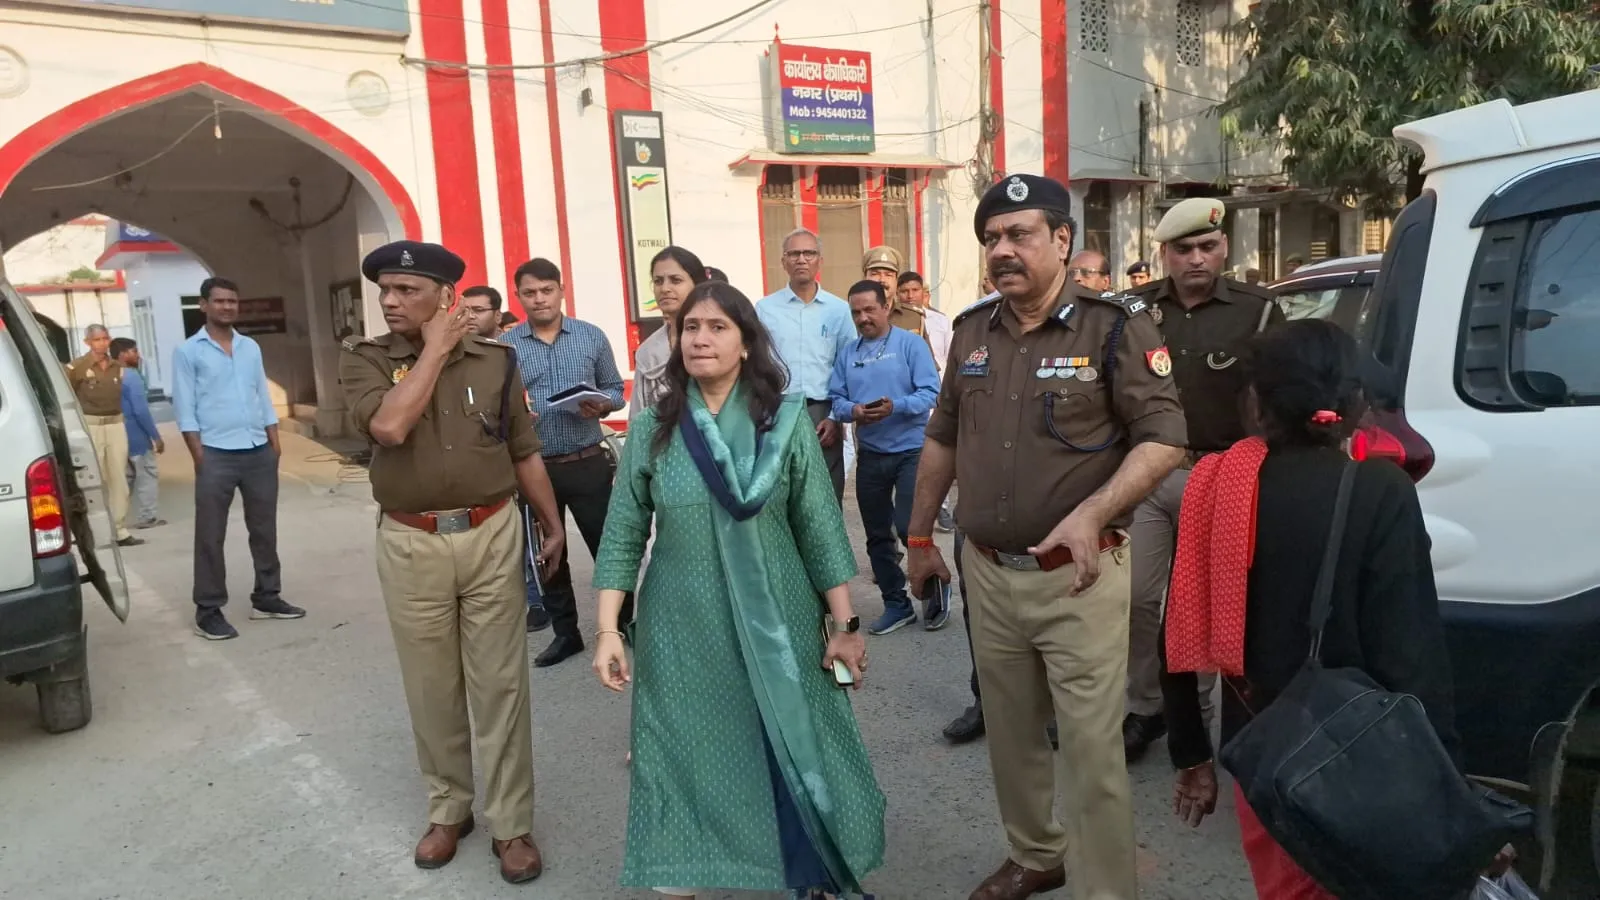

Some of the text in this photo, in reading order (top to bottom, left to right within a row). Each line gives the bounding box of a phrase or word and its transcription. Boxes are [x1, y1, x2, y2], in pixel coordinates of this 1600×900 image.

[783, 53, 822, 80] कार्यालय
[791, 84, 863, 106] नगर (प्रथम)
[637, 239, 666, 248] KOTWALI
